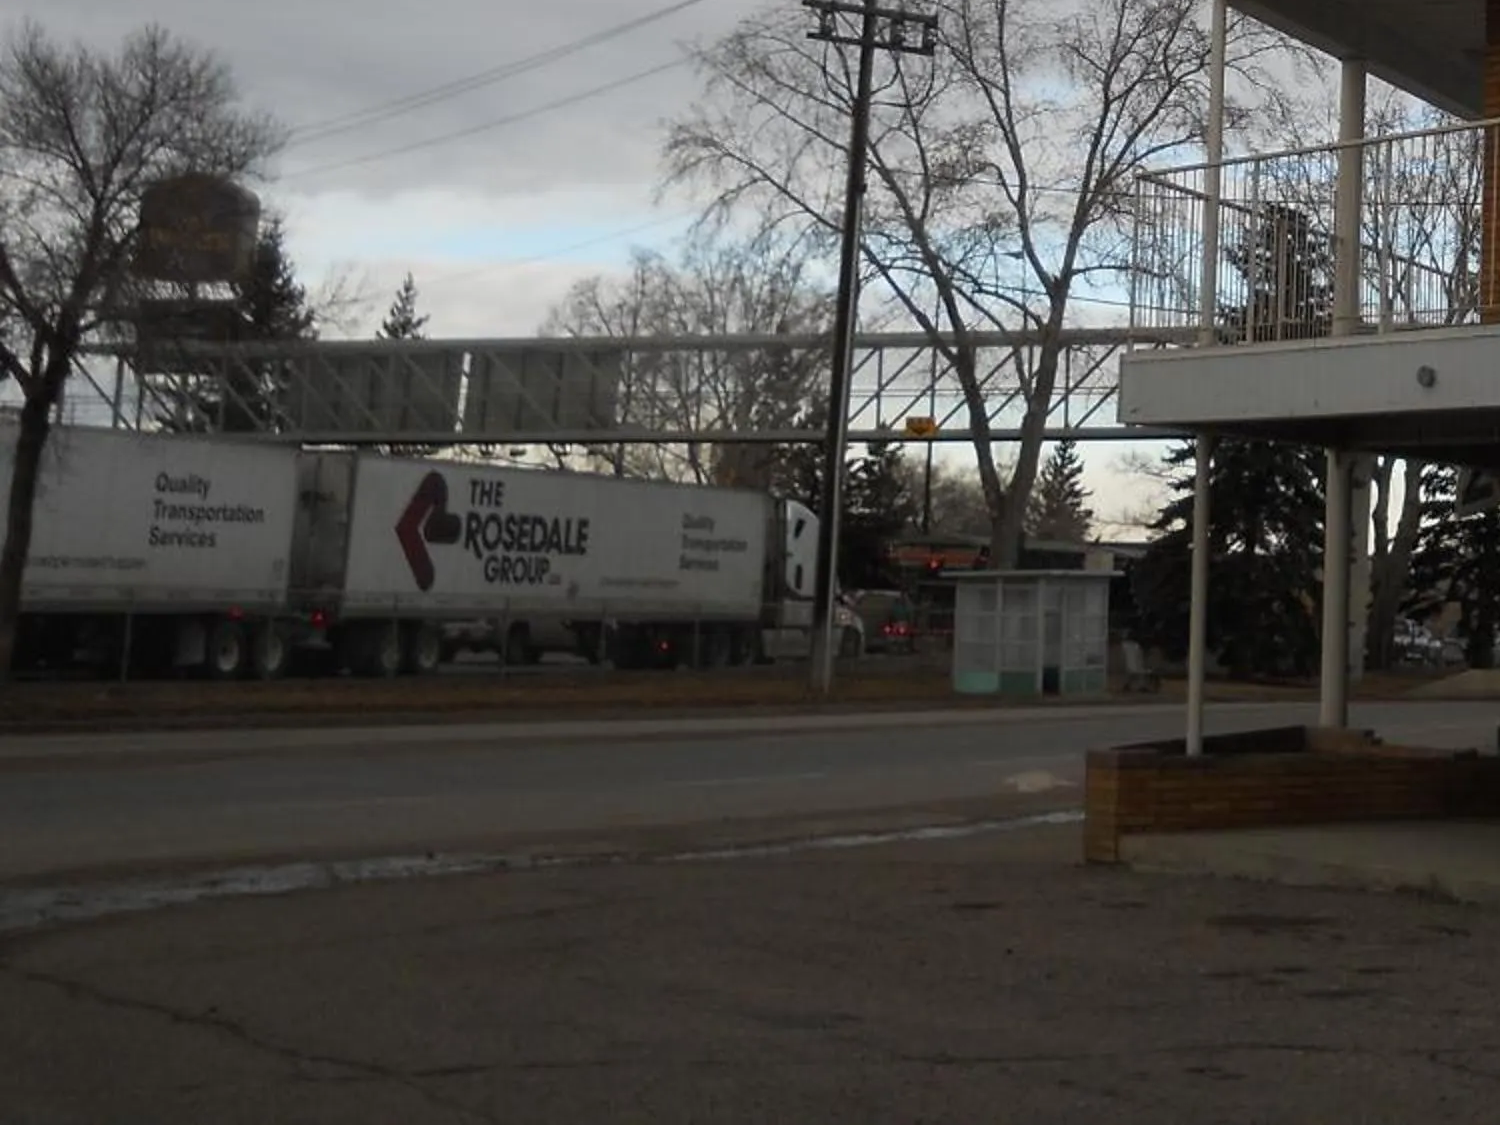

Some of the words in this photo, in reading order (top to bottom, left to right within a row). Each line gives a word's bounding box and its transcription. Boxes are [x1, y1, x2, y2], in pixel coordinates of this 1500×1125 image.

[154, 471, 212, 501] Quality
[469, 479, 505, 508] THE
[153, 498, 265, 526] Transportation
[148, 525, 217, 548] Services
[464, 511, 590, 560] ROSEDALE
[483, 554, 550, 585] GROUP
